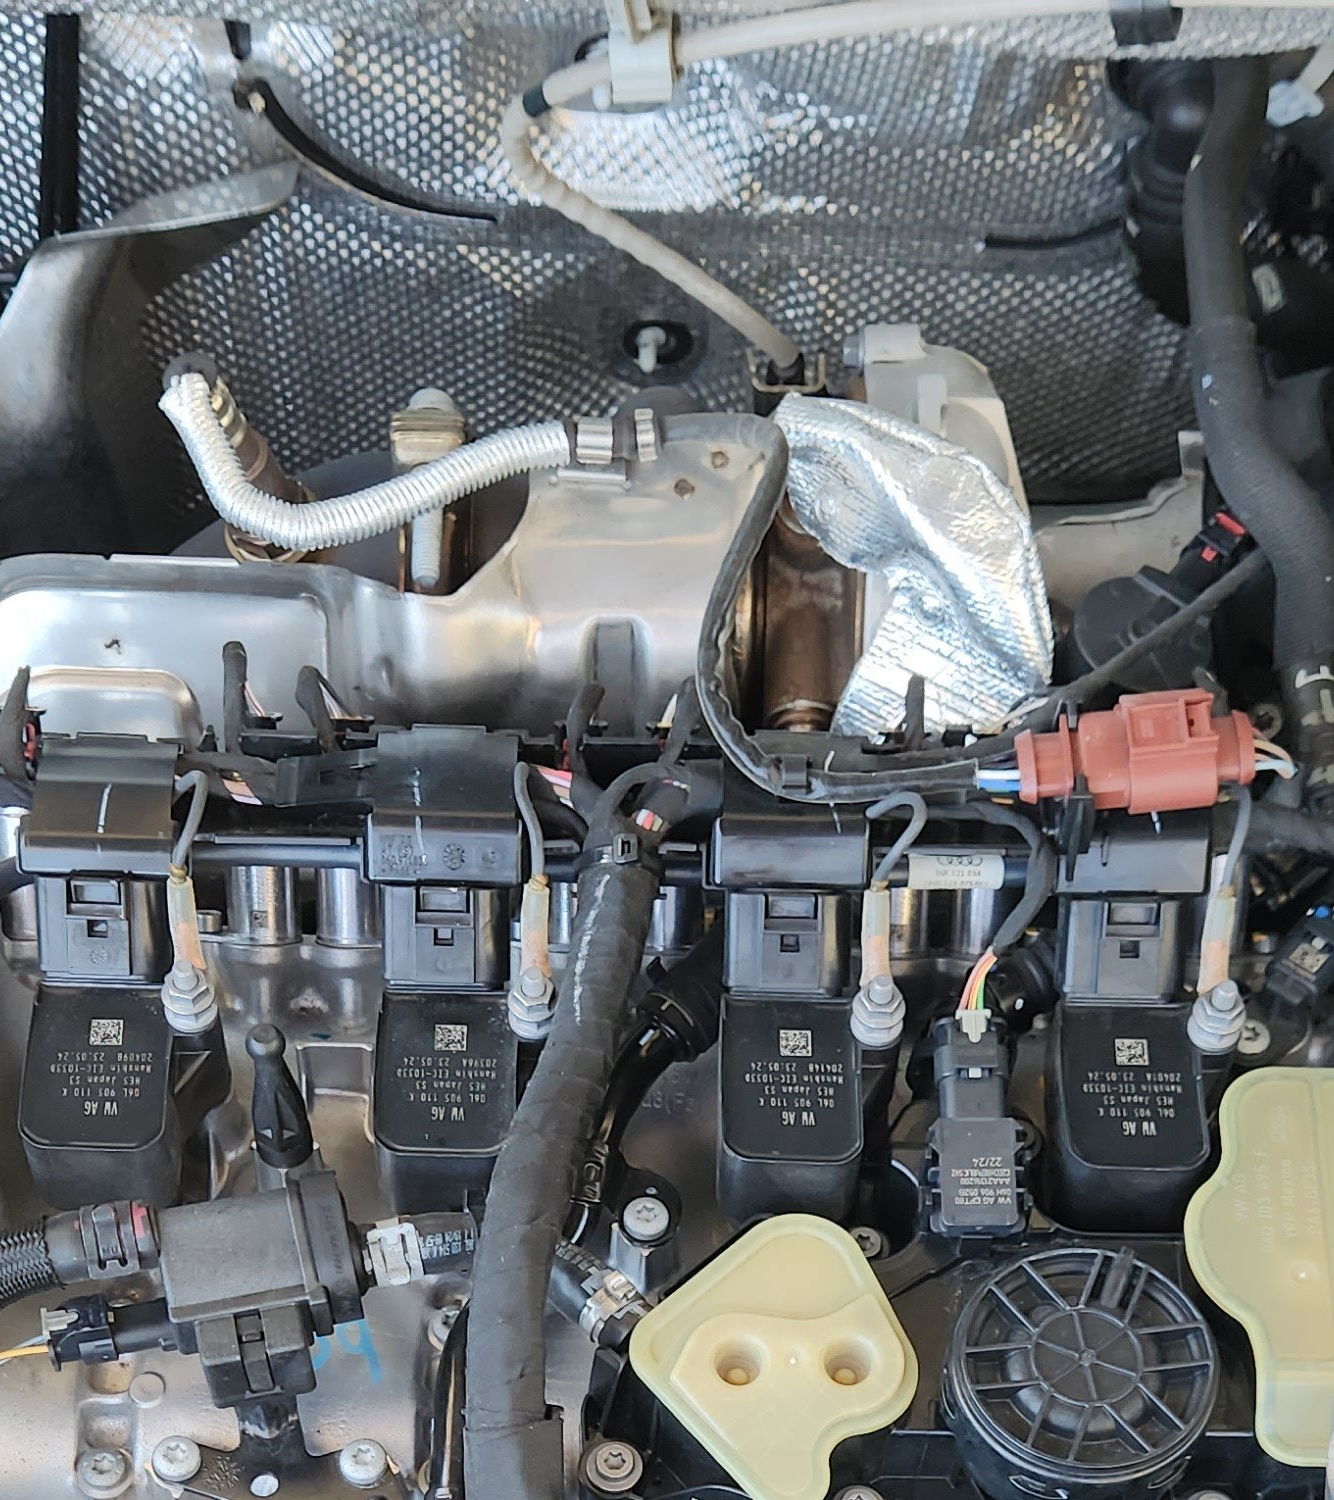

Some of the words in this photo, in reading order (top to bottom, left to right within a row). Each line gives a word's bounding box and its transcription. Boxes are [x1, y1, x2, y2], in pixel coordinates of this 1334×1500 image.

[73, 1087, 90, 1096] 110
[98, 1087, 115, 1096] 905
[421, 1092, 437, 1101] 110
[445, 1093, 461, 1102] 905
[770, 1097, 787, 1106] 110
[794, 1098, 811, 1106] 905
[83, 1100, 98, 1115] AG
[103, 1101, 117, 1115] VW
[431, 1106, 445, 1120] AG
[451, 1106, 464, 1120] VW
[1109, 1107, 1126, 1116] 110
[1133, 1108, 1150, 1116] 905
[781, 1111, 795, 1125] AG
[801, 1111, 815, 1125] VW
[1122, 1121, 1135, 1134] AG
[1142, 1121, 1156, 1135] VW
[972, 1157, 1002, 1168] 22/24
